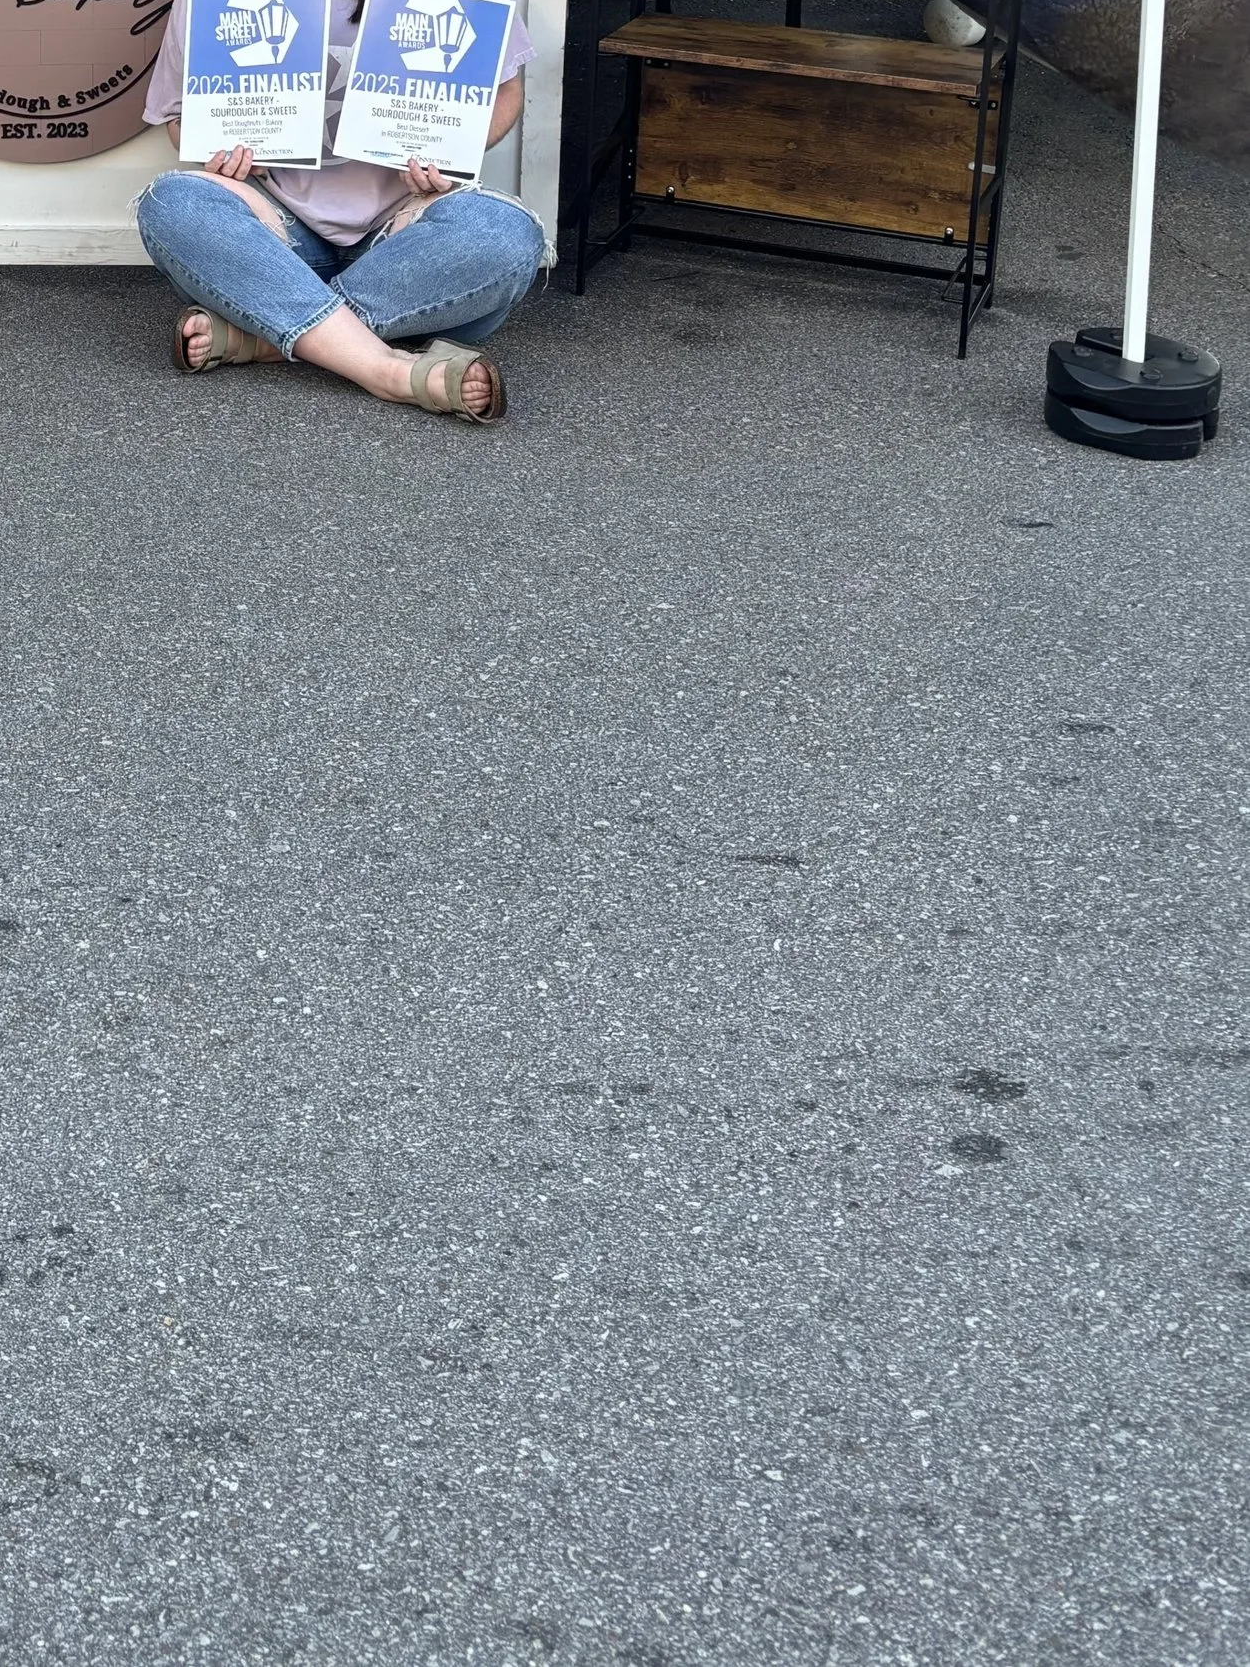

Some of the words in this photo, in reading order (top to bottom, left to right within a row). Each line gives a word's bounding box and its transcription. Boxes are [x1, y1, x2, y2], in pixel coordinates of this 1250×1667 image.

[219, 10, 252, 28] MAIN
[396, 12, 430, 30] MAIN
[215, 23, 257, 42] STREET
[225, 36, 253, 47] AWARDS
[390, 25, 433, 43] STREET
[398, 40, 426, 50] AWARDS
[56, 95, 72, 109] &
[76, 63, 134, 105] Sweets
[187, 74, 234, 96] 2025
[239, 71, 322, 95] FINALIST
[352, 71, 400, 97] 2025
[404, 77, 493, 107] FINALIST
[227, 97, 244, 107] S&S
[245, 96, 275, 106] BAKERY
[390, 98, 407, 110] S&S
[408, 101, 439, 113] BAKERY
[210, 107, 259, 118] SOURDOUGH
[261, 107, 267, 116] &
[268, 106, 298, 116] SWEETS
[371, 107, 420, 123] SOURDOUGH
[422, 113, 429, 123] &
[430, 114, 462, 127] SWEETS
[0, 123, 42, 140] EST.
[47, 122, 90, 139] 2023
[229, 128, 261, 136] ROBERTSON
[261, 127, 282, 135] COUNTY
[387, 130, 420, 141] ROBERTSON
[420, 134, 443, 143] COUNTY
